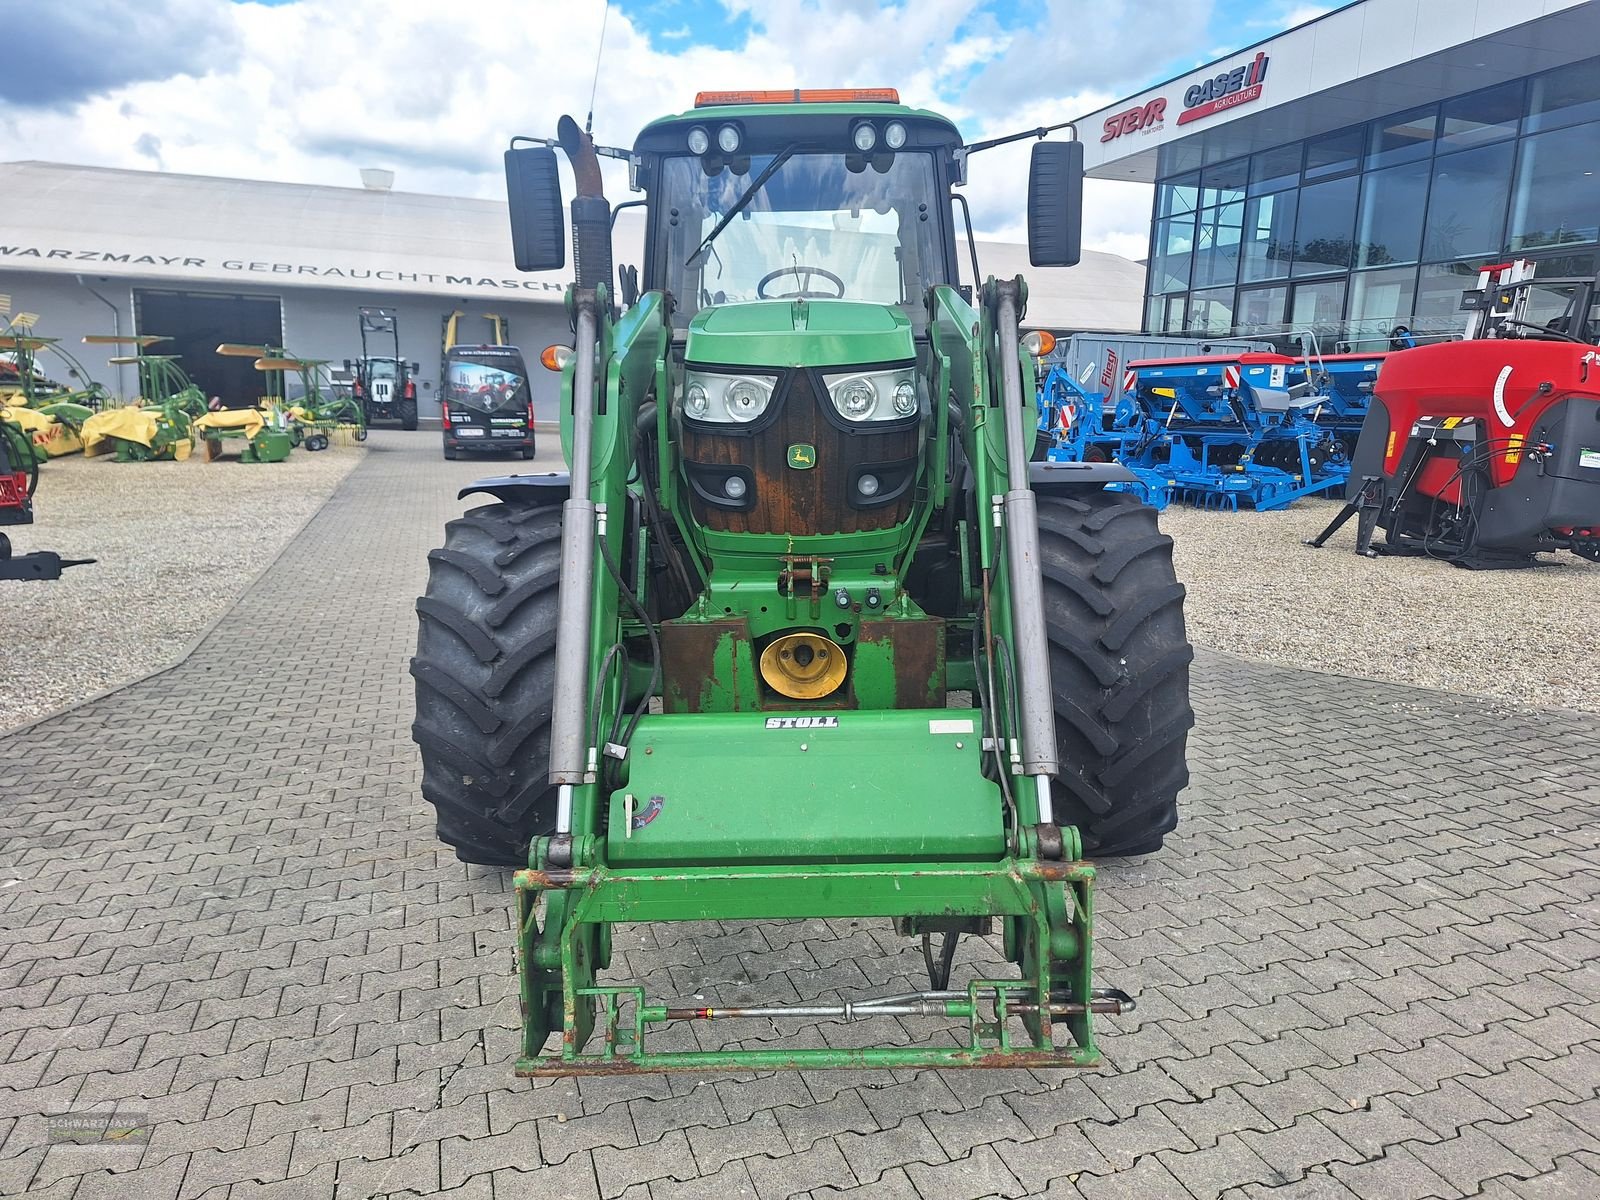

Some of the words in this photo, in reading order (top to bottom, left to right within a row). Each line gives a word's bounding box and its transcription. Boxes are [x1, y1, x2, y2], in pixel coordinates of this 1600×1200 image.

[1184, 66, 1246, 108] CASE
[1213, 87, 1257, 110] AGRICULTURE
[1100, 97, 1168, 143] STEYR
[221, 260, 569, 292] GEBRAUCHTMASCH
[1102, 348, 1118, 387] Fliegl
[765, 716, 838, 729] STOLL
